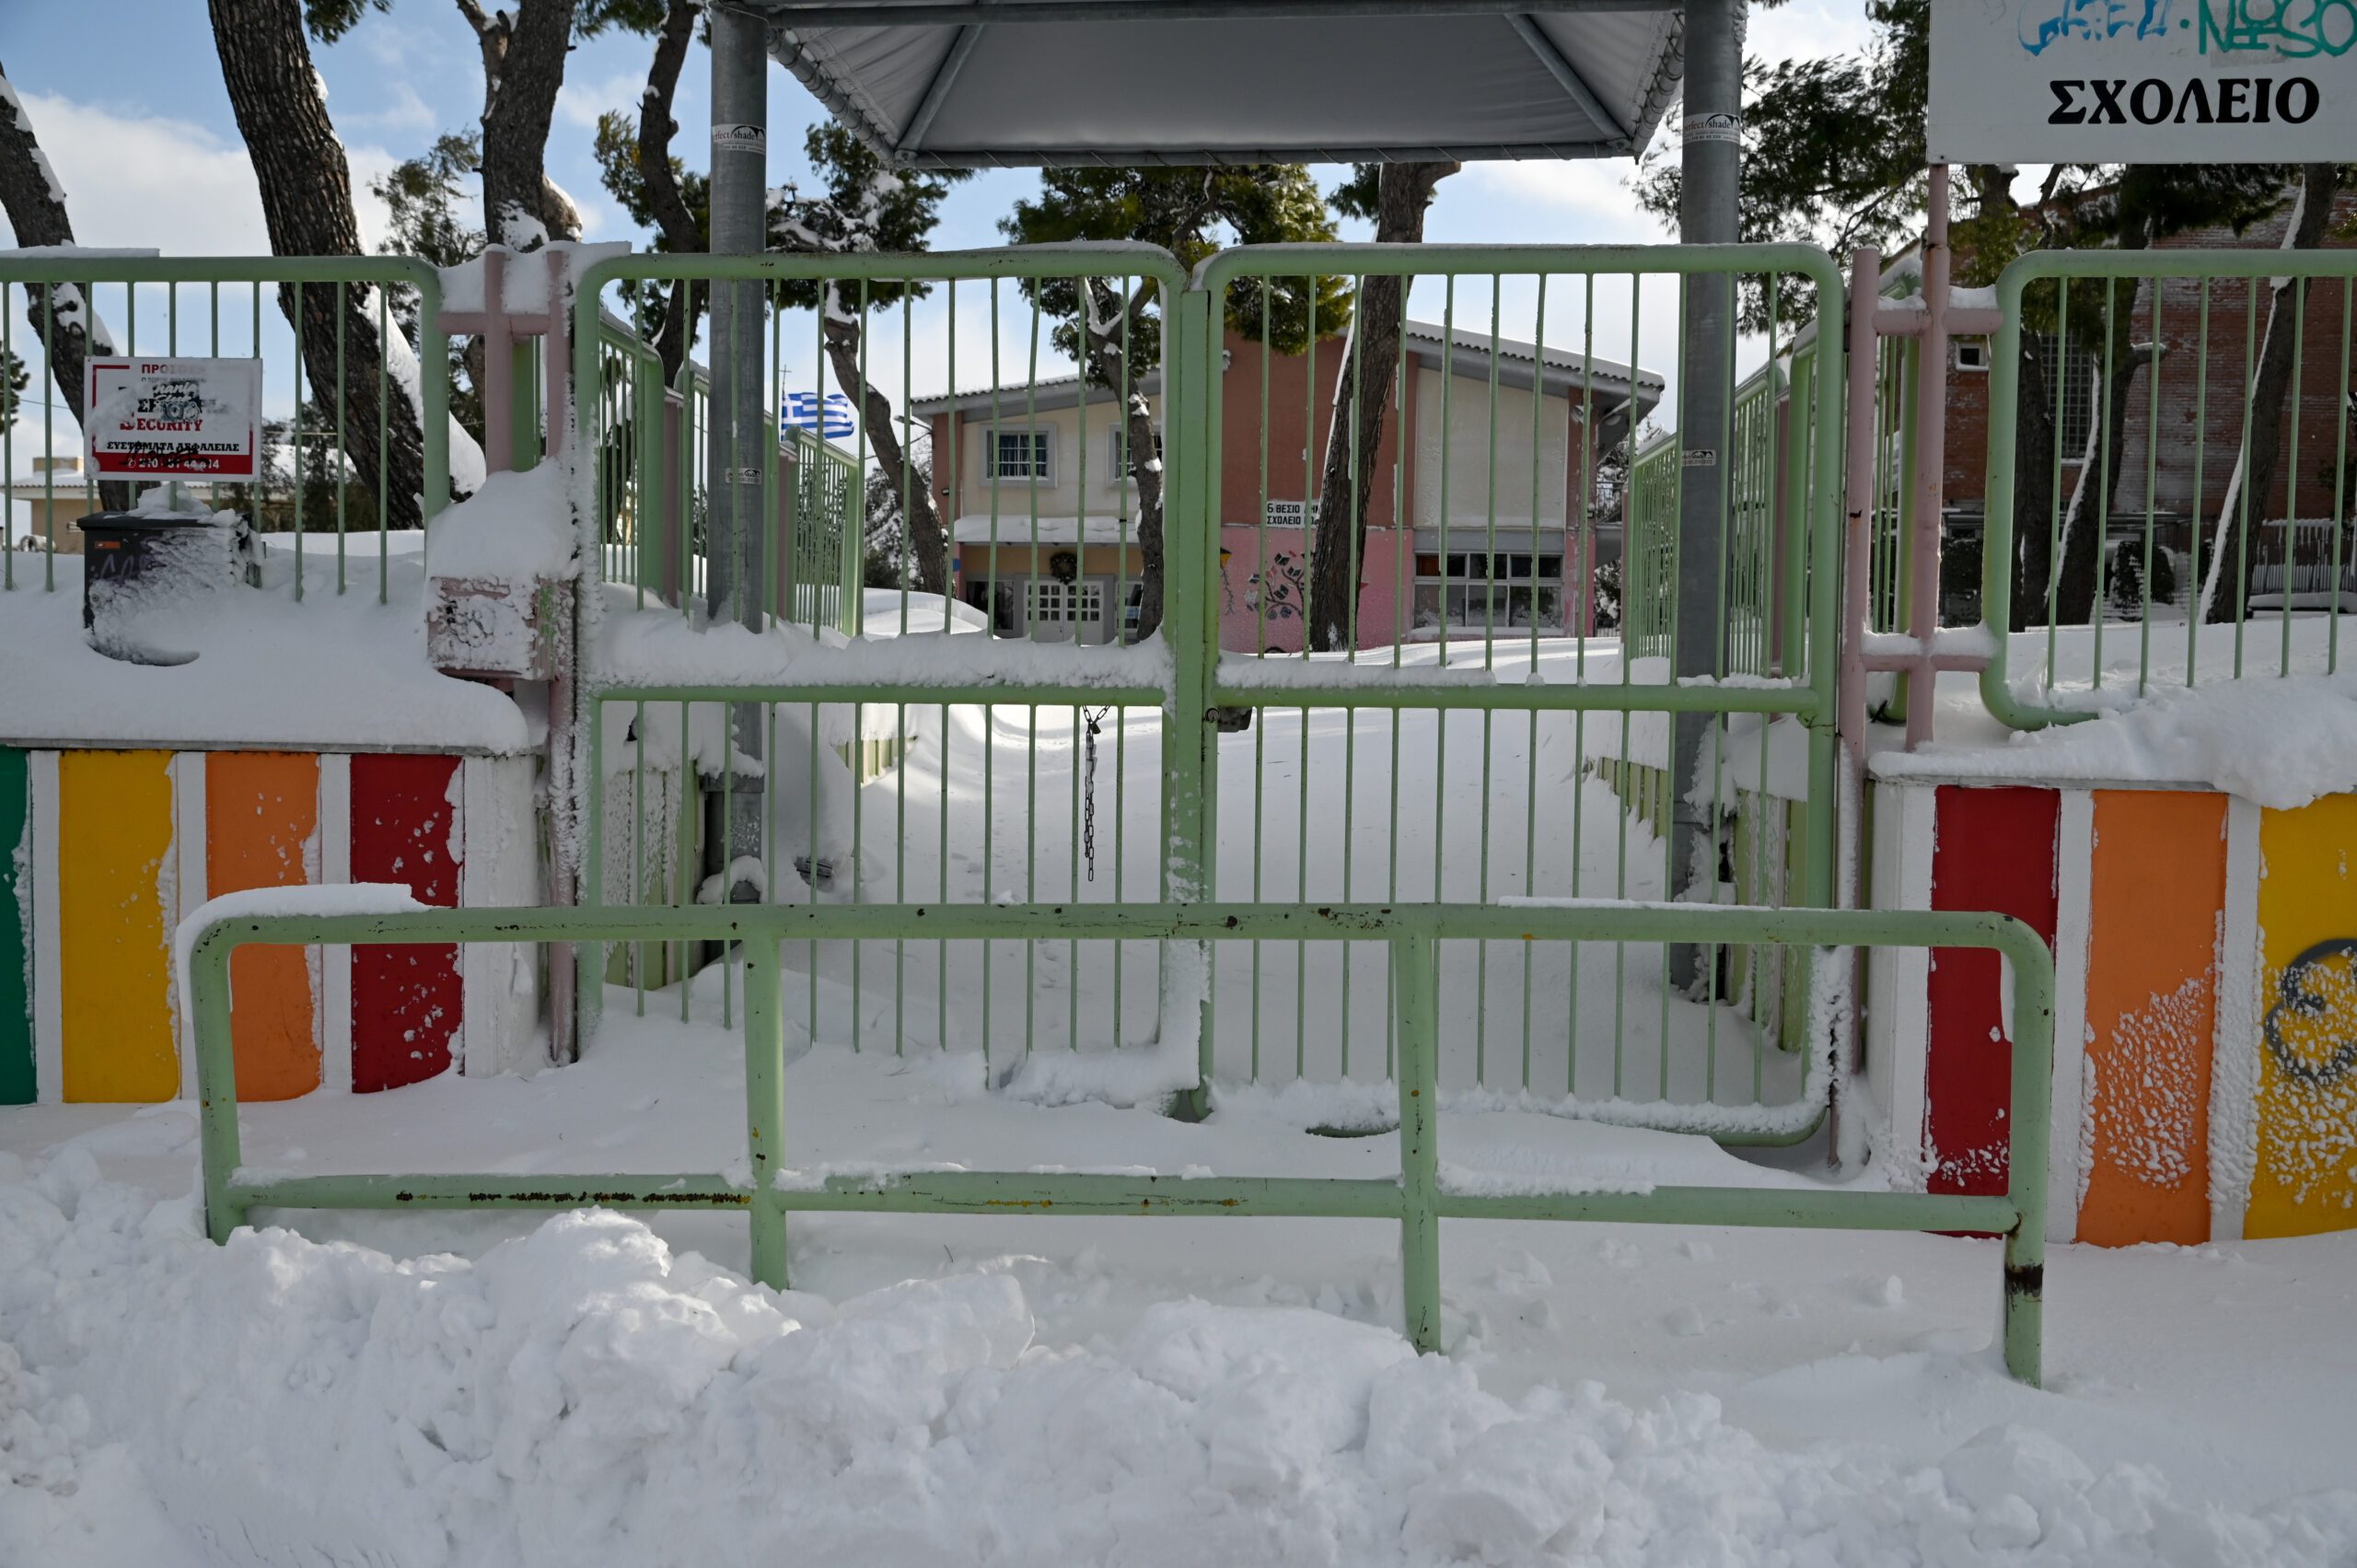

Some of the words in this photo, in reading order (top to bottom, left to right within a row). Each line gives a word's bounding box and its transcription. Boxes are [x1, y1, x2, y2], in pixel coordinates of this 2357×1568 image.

[2047, 76, 2320, 125] ΣΧΟΛΕΙΟ
[1684, 121, 1704, 132] erfect
[1708, 119, 1731, 130] shade
[714, 131, 730, 140] erfect
[734, 130, 755, 140] shade
[1267, 504, 1273, 513] 6
[1276, 505, 1300, 514] ΘΕΣΙΟ
[1267, 516, 1301, 525] ΣΧΟΛΕΙΟ
